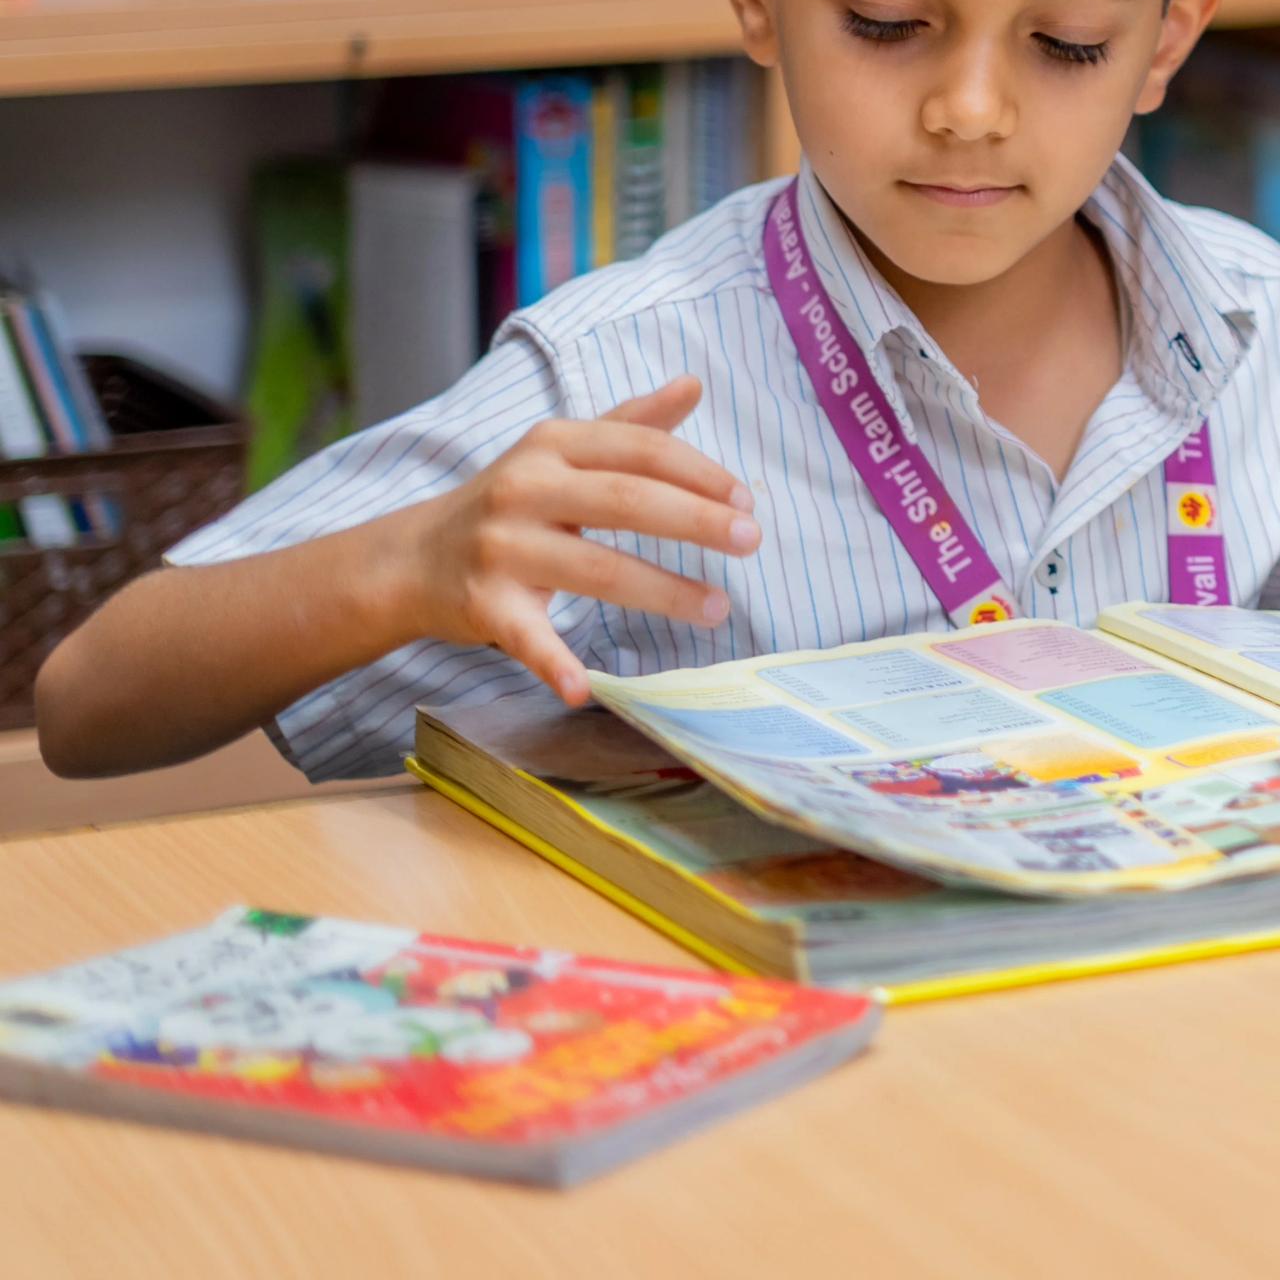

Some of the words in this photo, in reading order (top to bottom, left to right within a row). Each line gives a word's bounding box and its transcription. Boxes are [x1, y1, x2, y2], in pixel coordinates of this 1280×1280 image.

[800, 293, 860, 397] School
[849, 391, 901, 464] Ram
[883, 458, 939, 525] Shri
[929, 520, 973, 584] The
[883, 685, 925, 696] CRAFTS
[936, 679, 963, 688] ARTS
